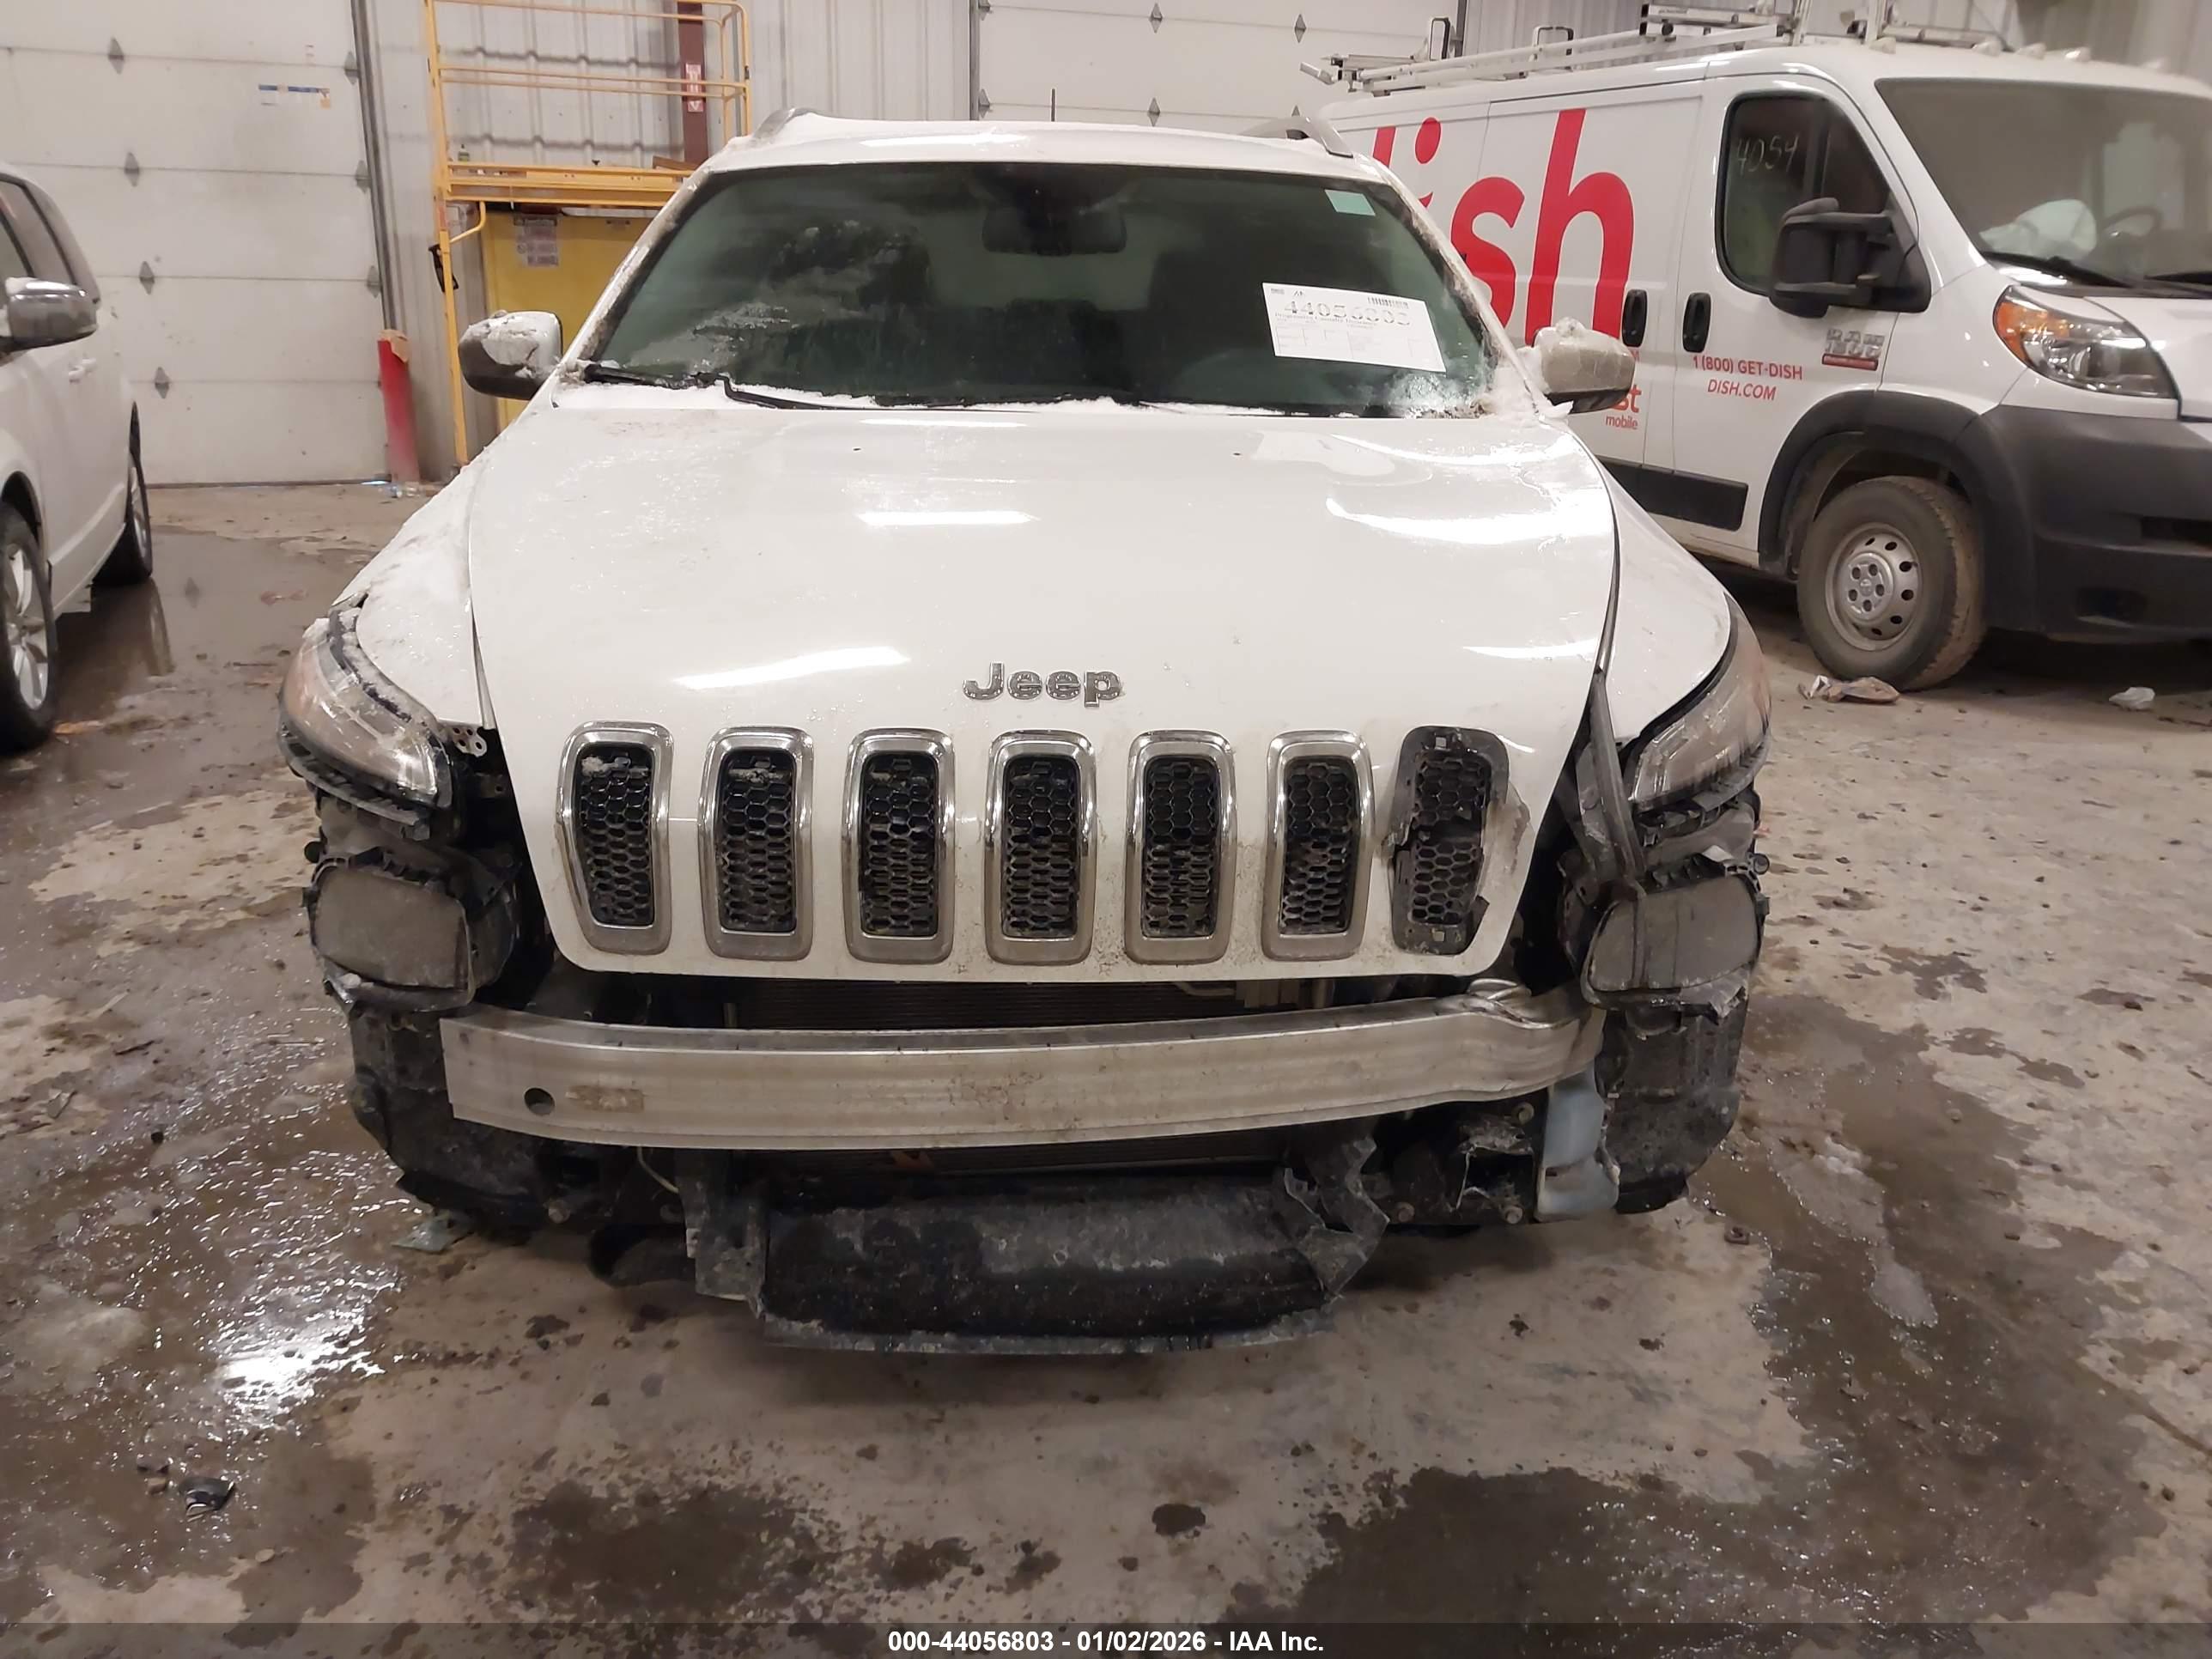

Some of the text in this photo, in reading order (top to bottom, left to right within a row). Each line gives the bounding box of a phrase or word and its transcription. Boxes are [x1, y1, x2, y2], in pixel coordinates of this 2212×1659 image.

[1737, 132, 1799, 176] 4054
[1693, 356, 1698, 369] 1
[1702, 356, 1733, 374] (800)
[1738, 360, 1803, 380] GET-DISH
[1708, 379, 1776, 400] DISH.COM
[1606, 415, 1638, 430] mobile
[963, 661, 1121, 708] Jeep
